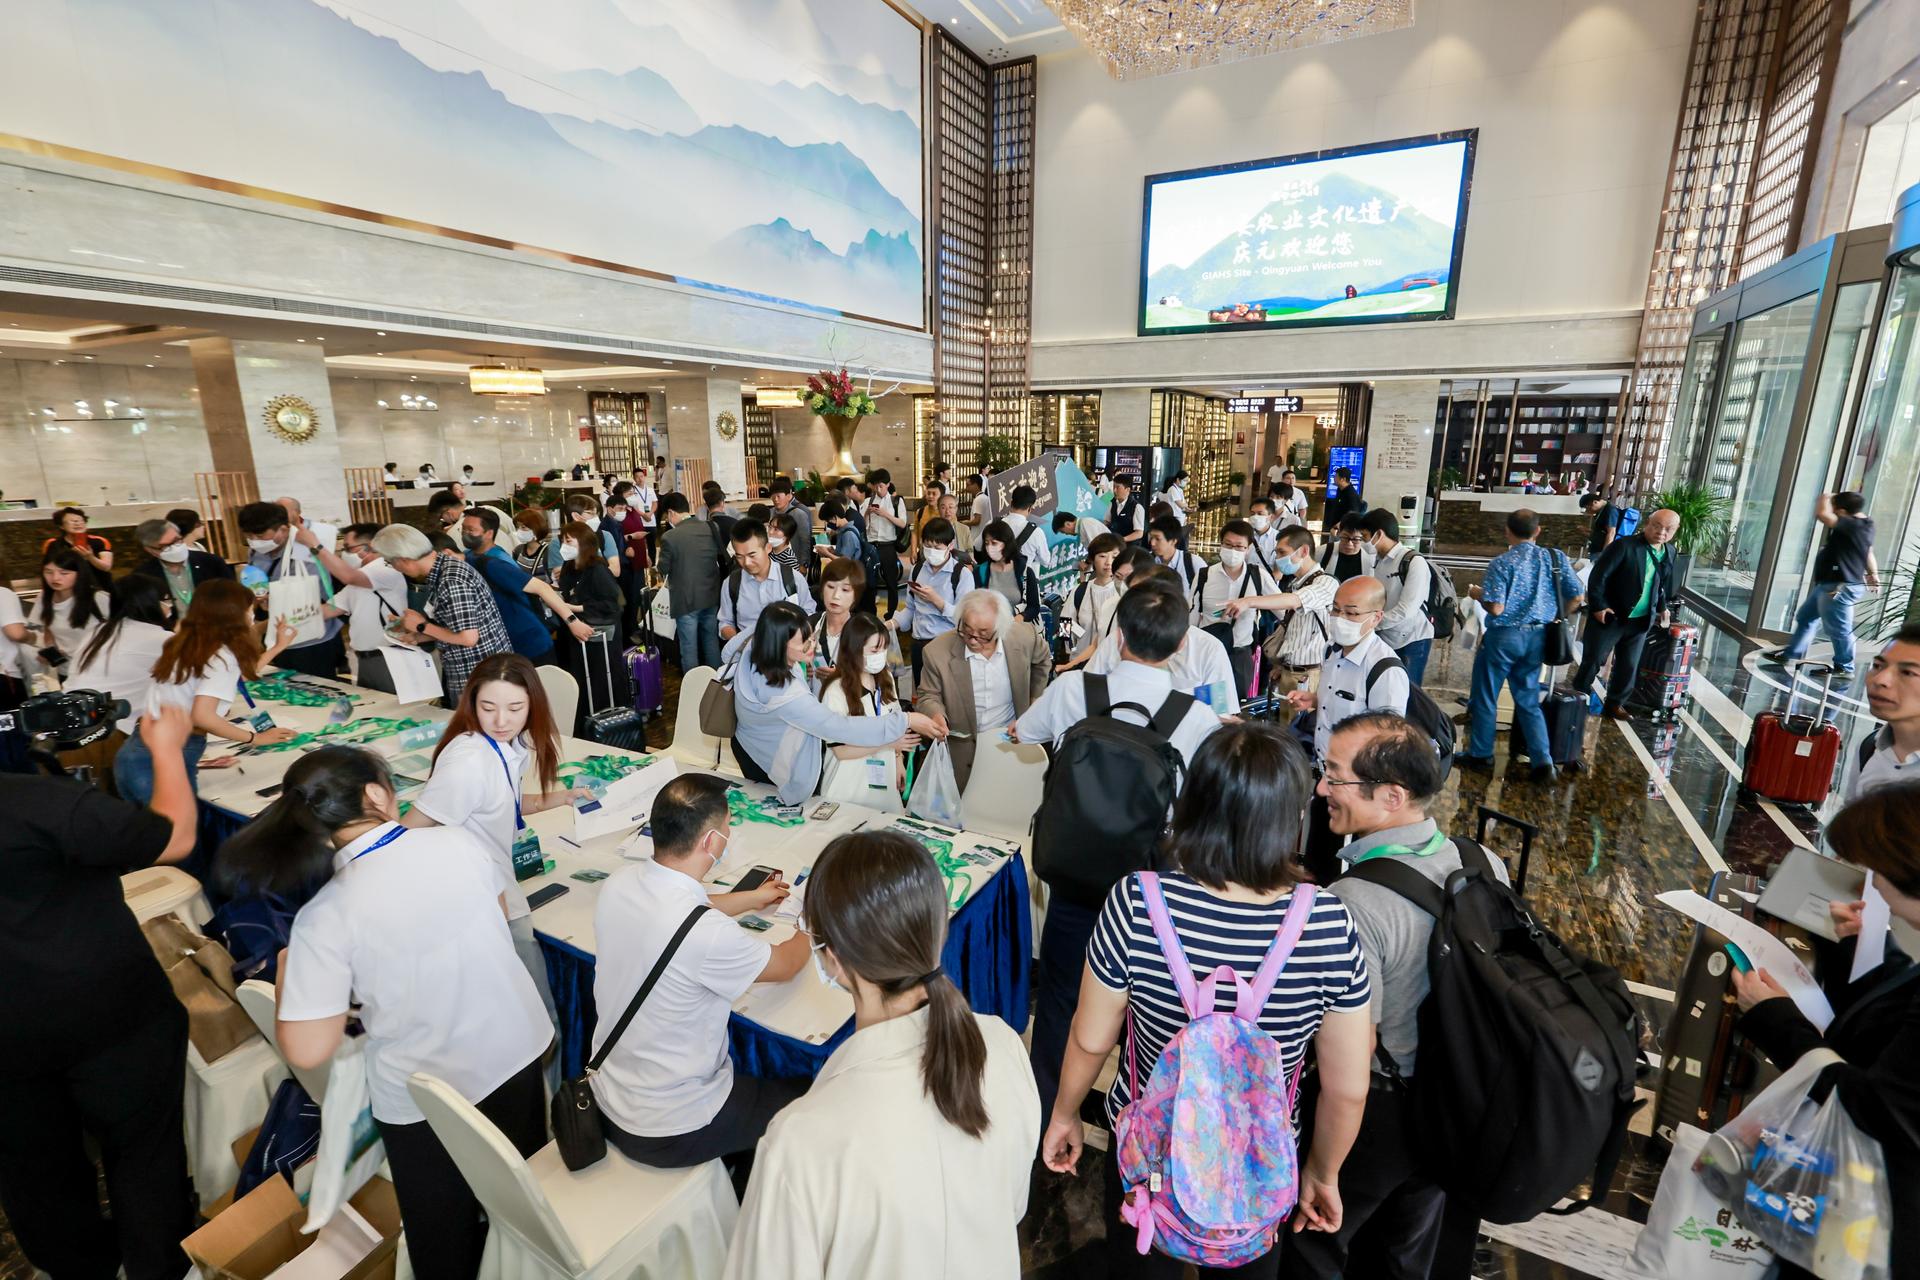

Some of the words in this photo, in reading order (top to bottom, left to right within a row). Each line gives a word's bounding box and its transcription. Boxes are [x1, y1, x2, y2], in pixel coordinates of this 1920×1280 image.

[1233, 231, 1355, 265] 庆元欢迎您
[1202, 268, 1232, 281] GIAHS
[1234, 266, 1252, 277] Site
[1262, 264, 1308, 276] Qingyuan
[1312, 259, 1359, 271] Welcome
[1362, 257, 1383, 267] You
[79, 726, 108, 746] RONIN
[516, 850, 539, 865] 工作证
